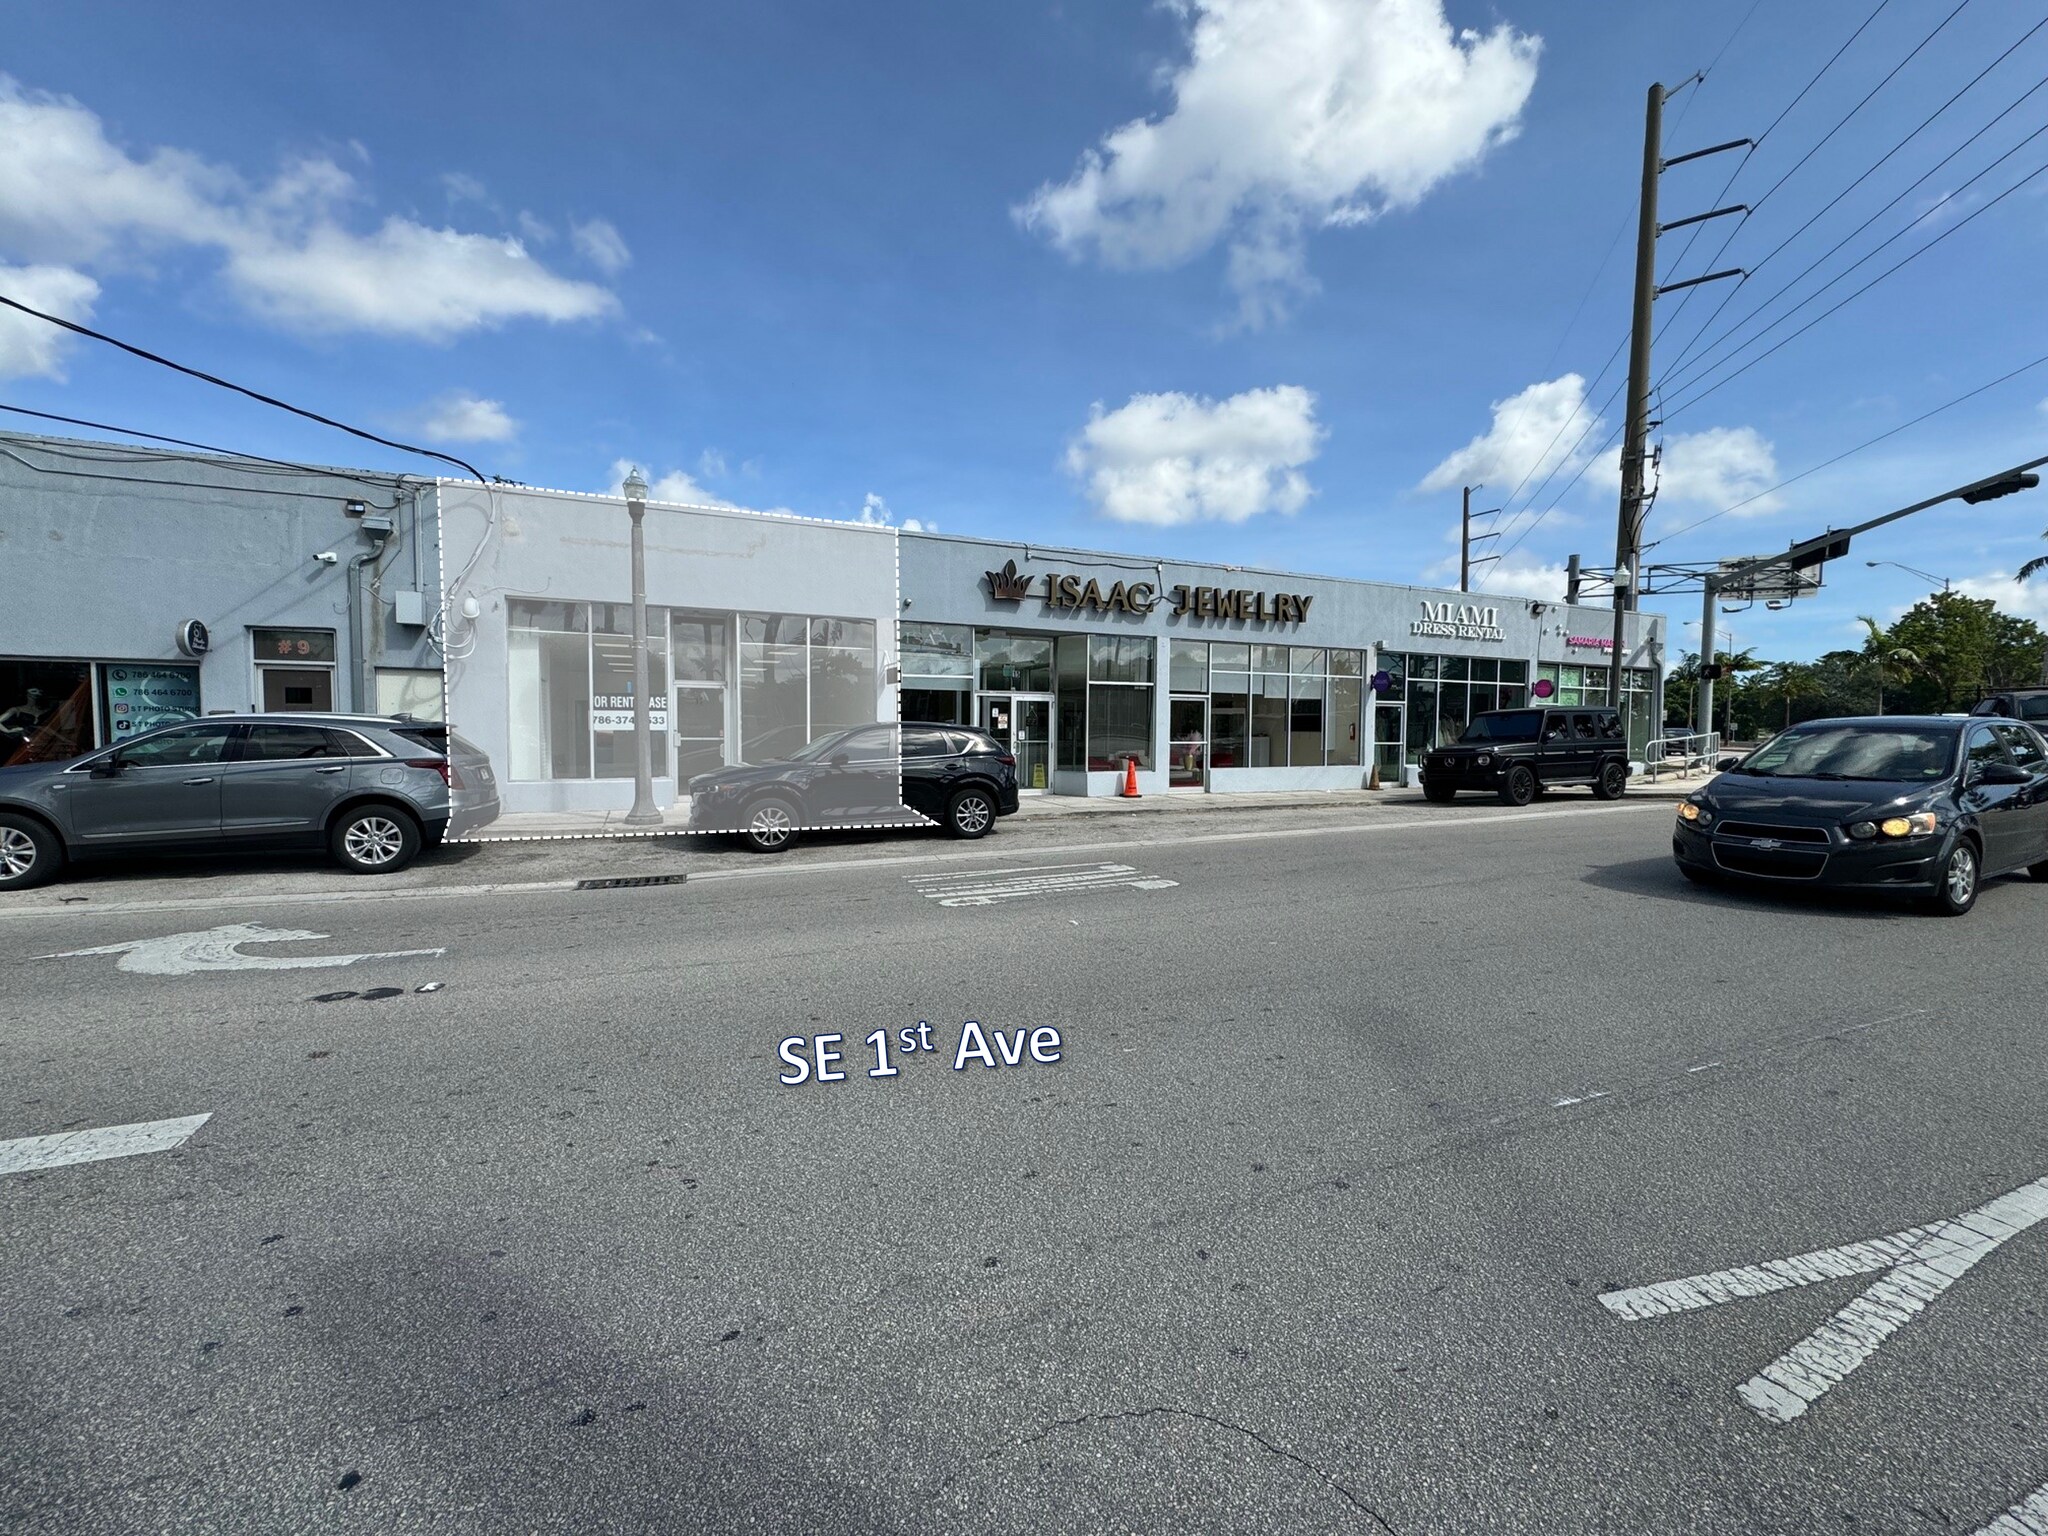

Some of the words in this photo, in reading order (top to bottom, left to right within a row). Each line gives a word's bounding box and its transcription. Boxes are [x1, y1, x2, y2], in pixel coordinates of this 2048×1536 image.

[1047, 573, 1155, 614] ISAAC
[1173, 584, 1314, 623] JEWELRY
[1421, 600, 1499, 628] MIAMI
[1412, 621, 1457, 636] DRESS
[1457, 625, 1507, 640] RENTAL
[133, 688, 150, 696] 786
[151, 688, 168, 696] 464
[170, 688, 192, 696] 6700
[592, 695, 608, 708] OR
[610, 696, 635, 708] RENT
[649, 696, 667, 708] ASE
